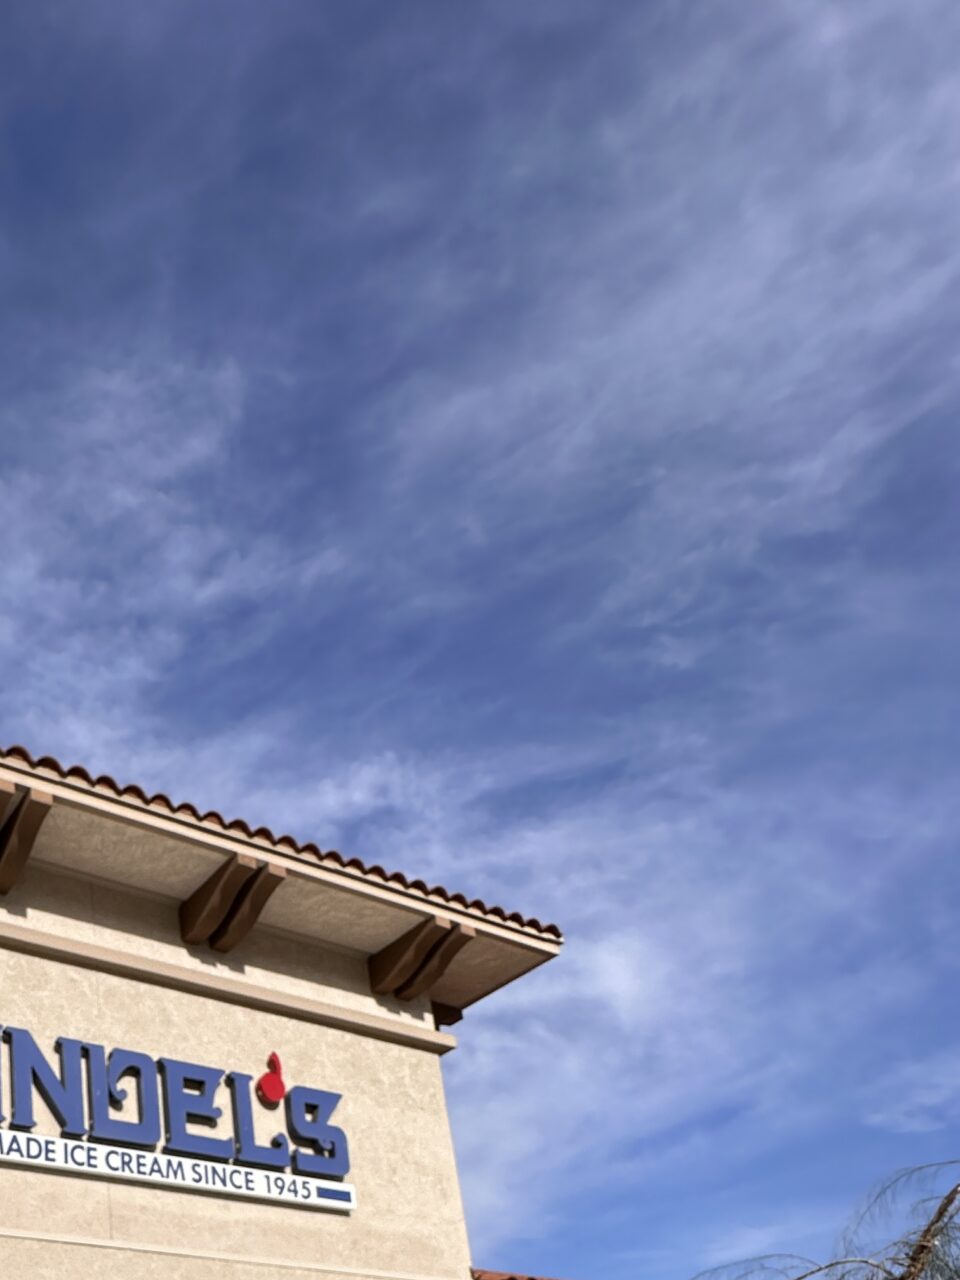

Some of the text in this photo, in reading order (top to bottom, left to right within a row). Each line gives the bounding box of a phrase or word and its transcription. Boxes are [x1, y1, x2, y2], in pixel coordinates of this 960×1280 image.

[63, 1142, 98, 1169] ICE
[105, 1149, 186, 1181] CREAM
[192, 1162, 256, 1192] SINCE
[263, 1174, 312, 1200] 1945
